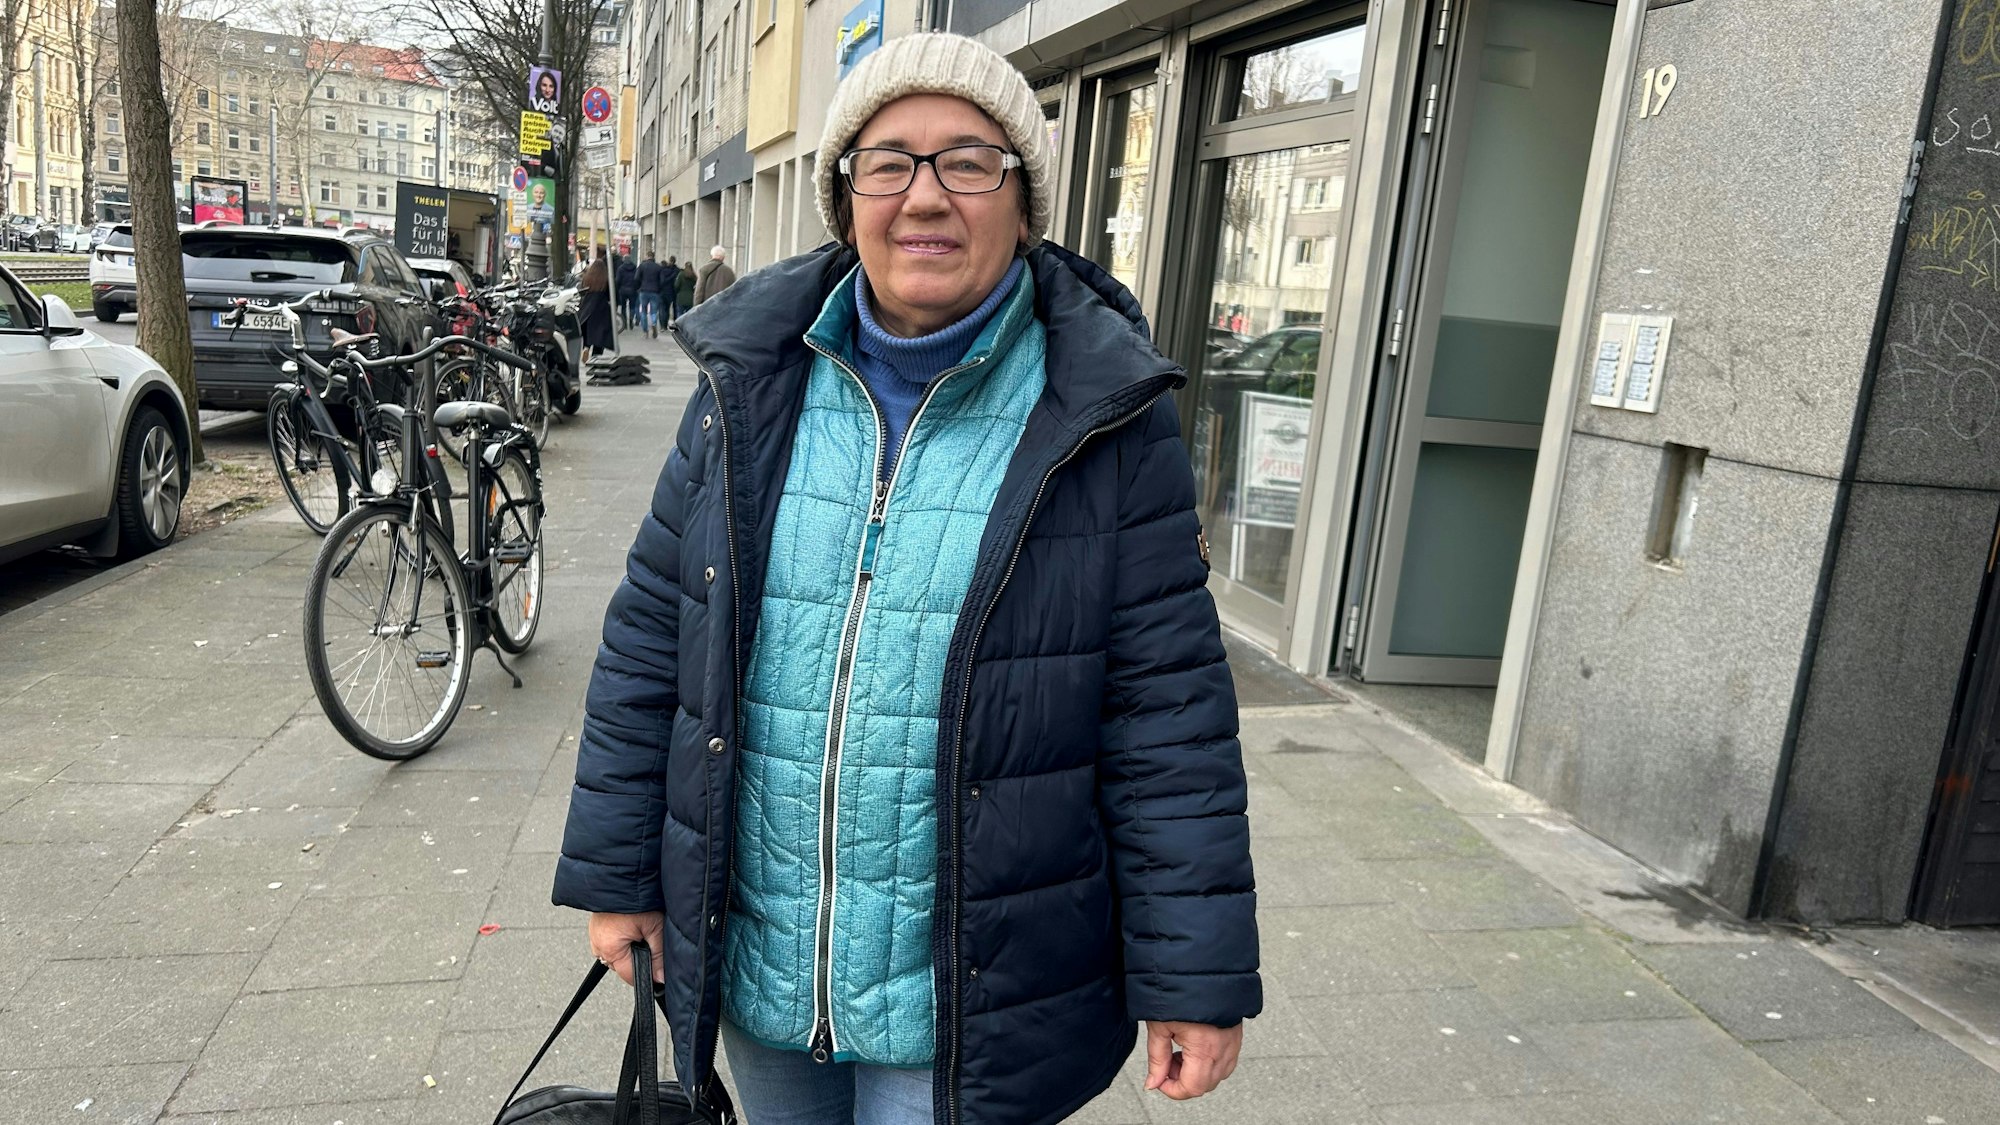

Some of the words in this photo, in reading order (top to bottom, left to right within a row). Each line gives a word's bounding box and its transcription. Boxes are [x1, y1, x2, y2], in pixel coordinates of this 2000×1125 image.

[1640, 64, 1677, 118] 19
[531, 98, 559, 114] Volt
[523, 121, 550, 129] geben.
[522, 140, 549, 148] Deinen
[414, 196, 446, 207] THELEN
[413, 212, 438, 227] Das
[412, 226, 433, 240] für
